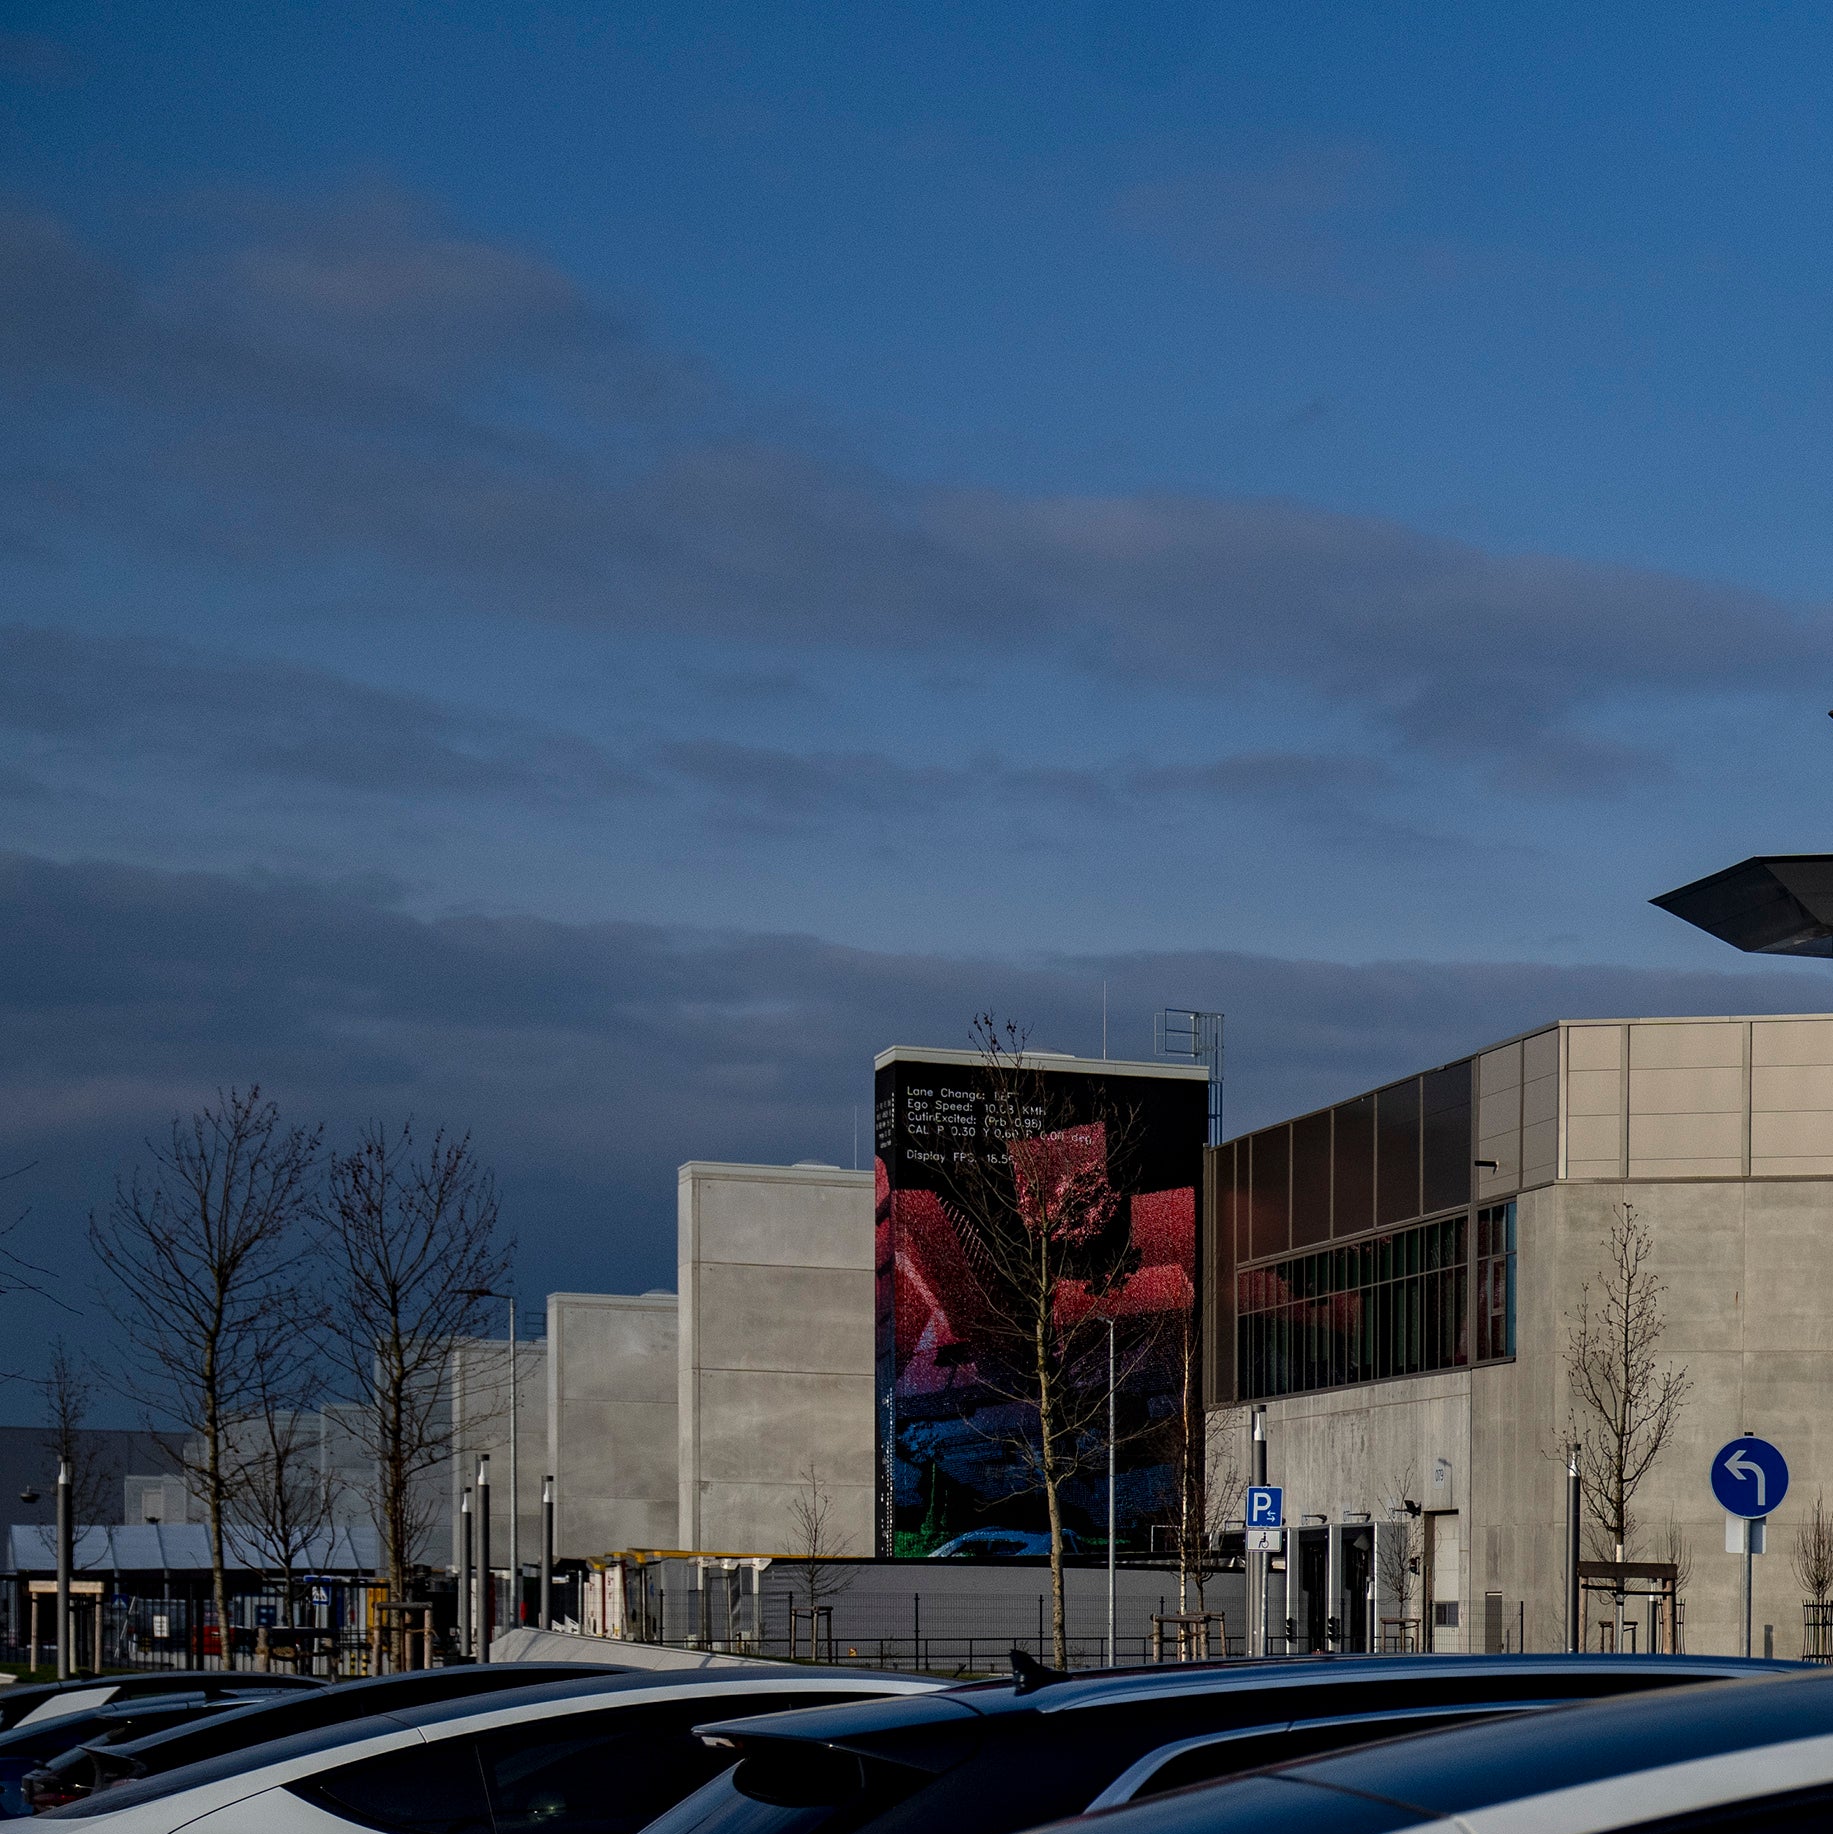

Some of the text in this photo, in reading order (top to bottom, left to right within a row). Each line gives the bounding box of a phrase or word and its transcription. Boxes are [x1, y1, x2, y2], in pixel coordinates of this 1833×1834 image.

[907, 1085, 934, 1096] Lane
[907, 1098, 928, 1111] Ego
[935, 1100, 973, 1112] Speed:
[1022, 1106, 1047, 1116] KMH
[907, 1124, 929, 1135] CAL
[937, 1125, 945, 1135] P
[951, 1126, 976, 1137] 0.30
[983, 1127, 990, 1137] Y
[906, 1149, 945, 1164] Display
[1252, 1492, 1272, 1522] P
